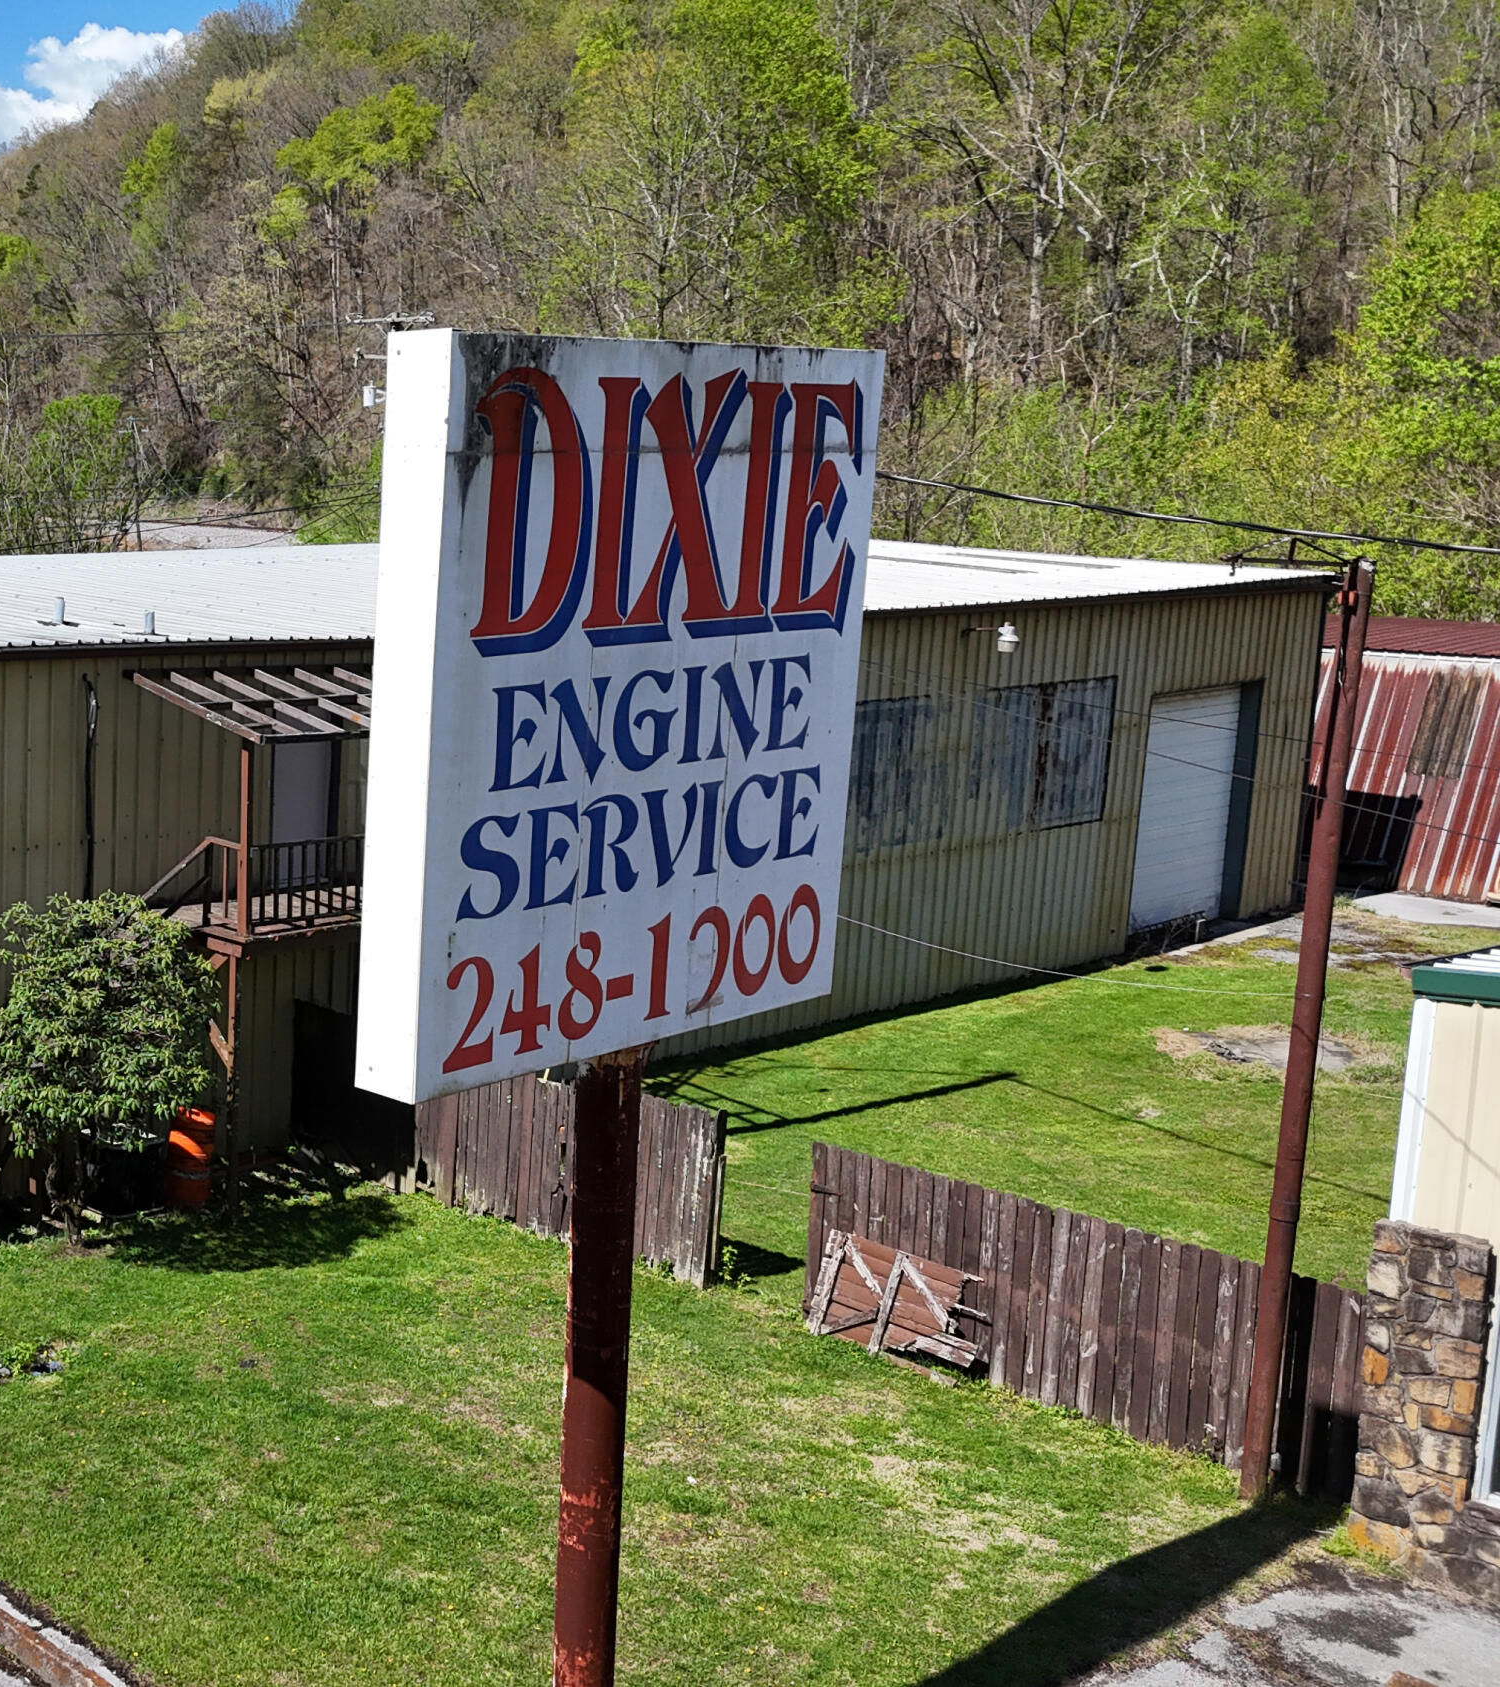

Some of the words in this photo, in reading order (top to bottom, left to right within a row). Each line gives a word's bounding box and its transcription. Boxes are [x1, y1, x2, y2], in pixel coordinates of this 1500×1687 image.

[470, 367, 862, 656] DIXIE
[488, 654, 811, 792] ENGINE
[456, 765, 821, 922] SERVICE
